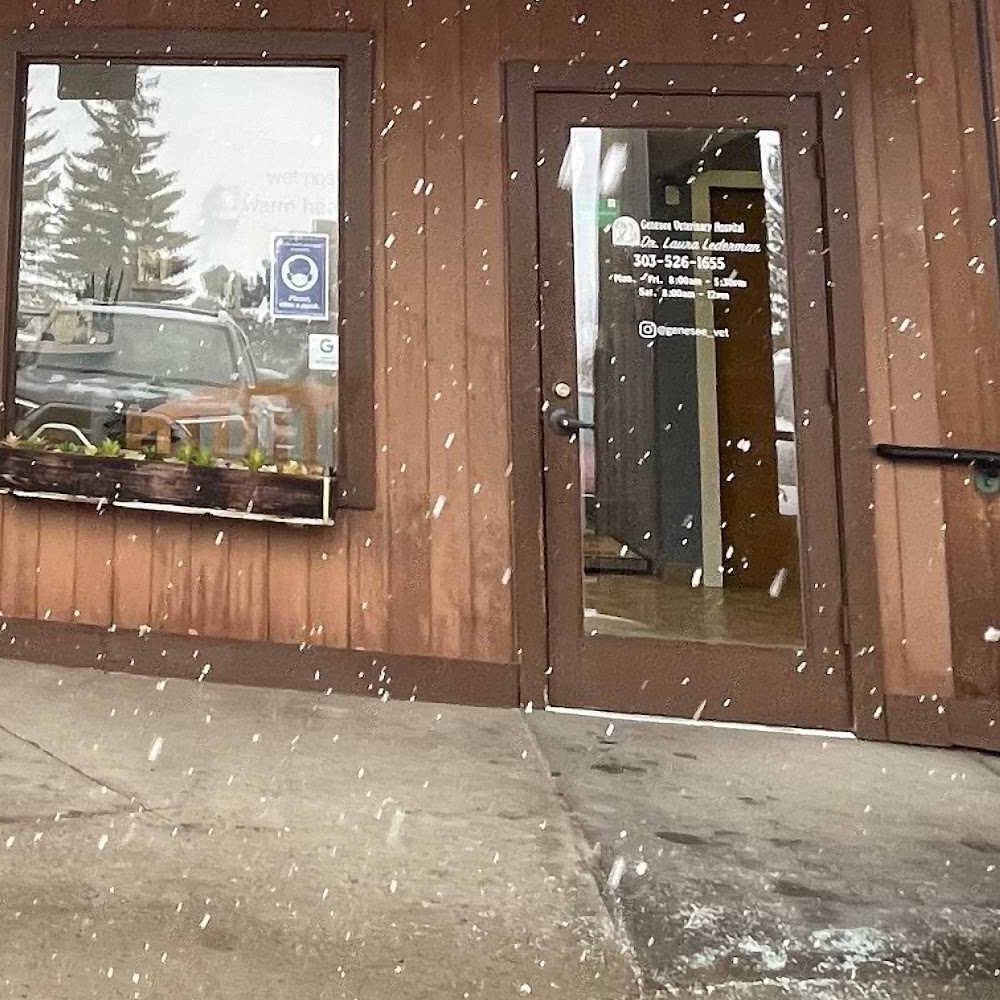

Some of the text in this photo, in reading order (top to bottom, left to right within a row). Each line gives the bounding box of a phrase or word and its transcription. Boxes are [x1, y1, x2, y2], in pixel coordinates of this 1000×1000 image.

[673, 220, 712, 233] Veterinary
[714, 222, 745, 233] Hospital
[640, 235, 762, 253] Dr. Laura Lederman
[633, 254, 726, 270] 303-526-1655
[648, 274, 664, 285] Fri.
[638, 287, 658, 298] Sat.
[707, 290, 730, 301] 12pm
[657, 325, 730, 339] @genesee_vet
